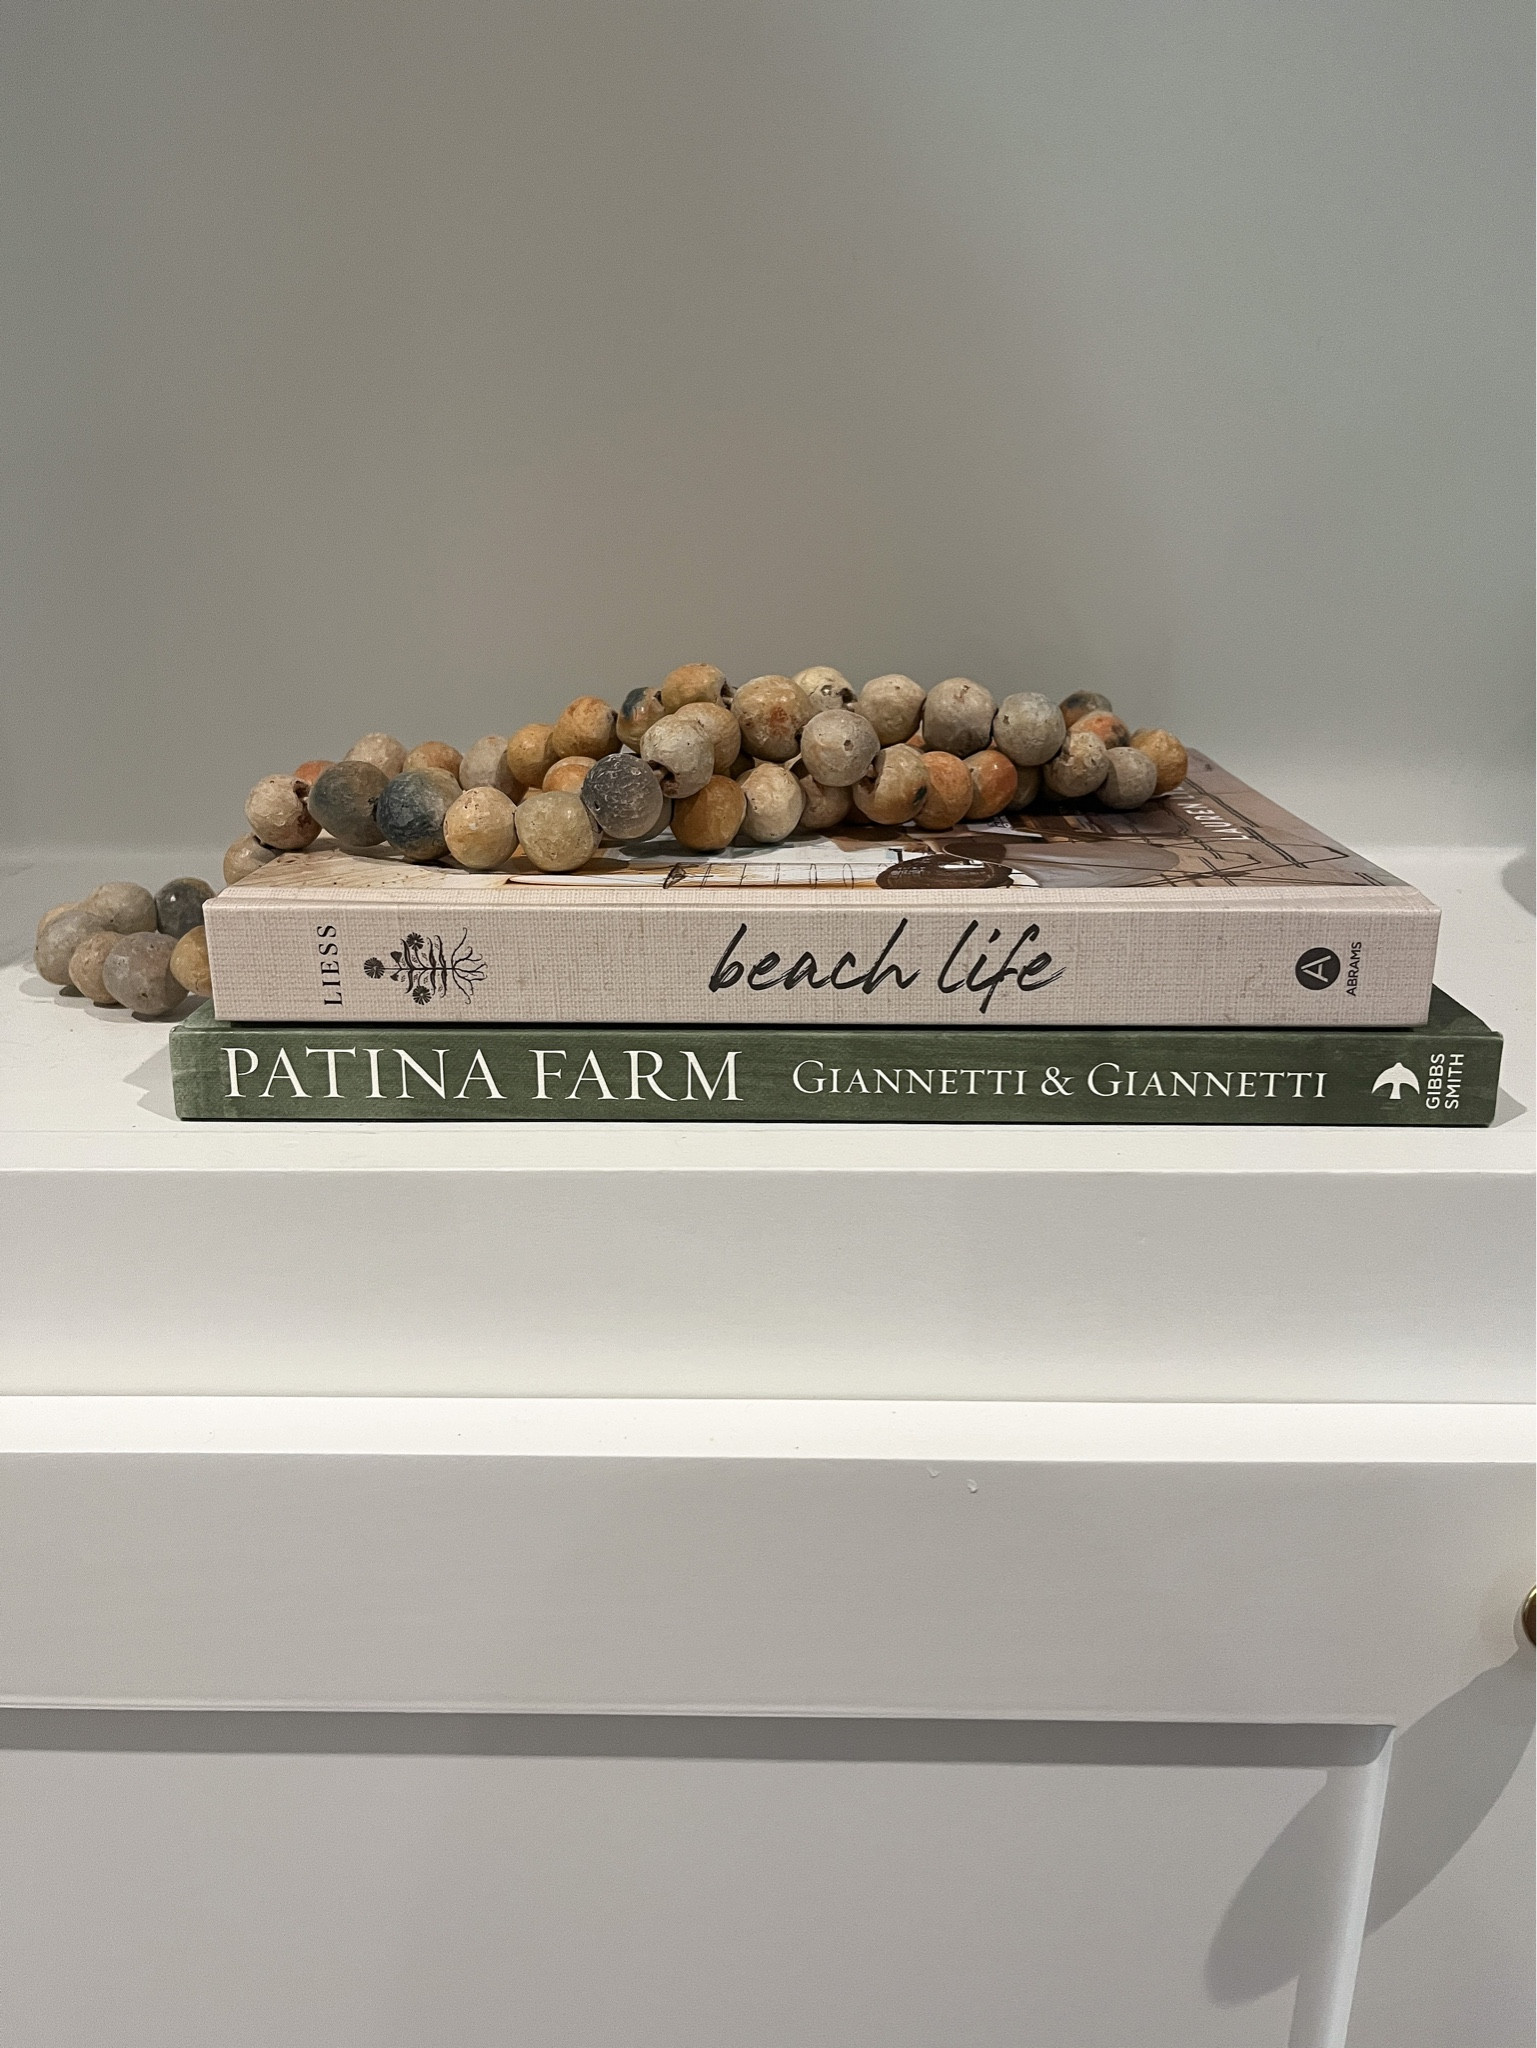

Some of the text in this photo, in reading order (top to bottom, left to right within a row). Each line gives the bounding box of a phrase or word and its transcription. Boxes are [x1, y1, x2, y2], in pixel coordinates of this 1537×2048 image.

[1176, 802, 1250, 841] LAUREN
[317, 925, 343, 1006] LIESS
[708, 919, 1067, 1015] beach life
[1345, 941, 1363, 997] ABRAMS
[220, 1046, 744, 1102] PATINA FARM
[792, 1059, 1327, 1099] GIANNETTI & GIANNETTI
[1426, 1053, 1445, 1110] GIBBS
[1444, 1053, 1465, 1111] SMITH
